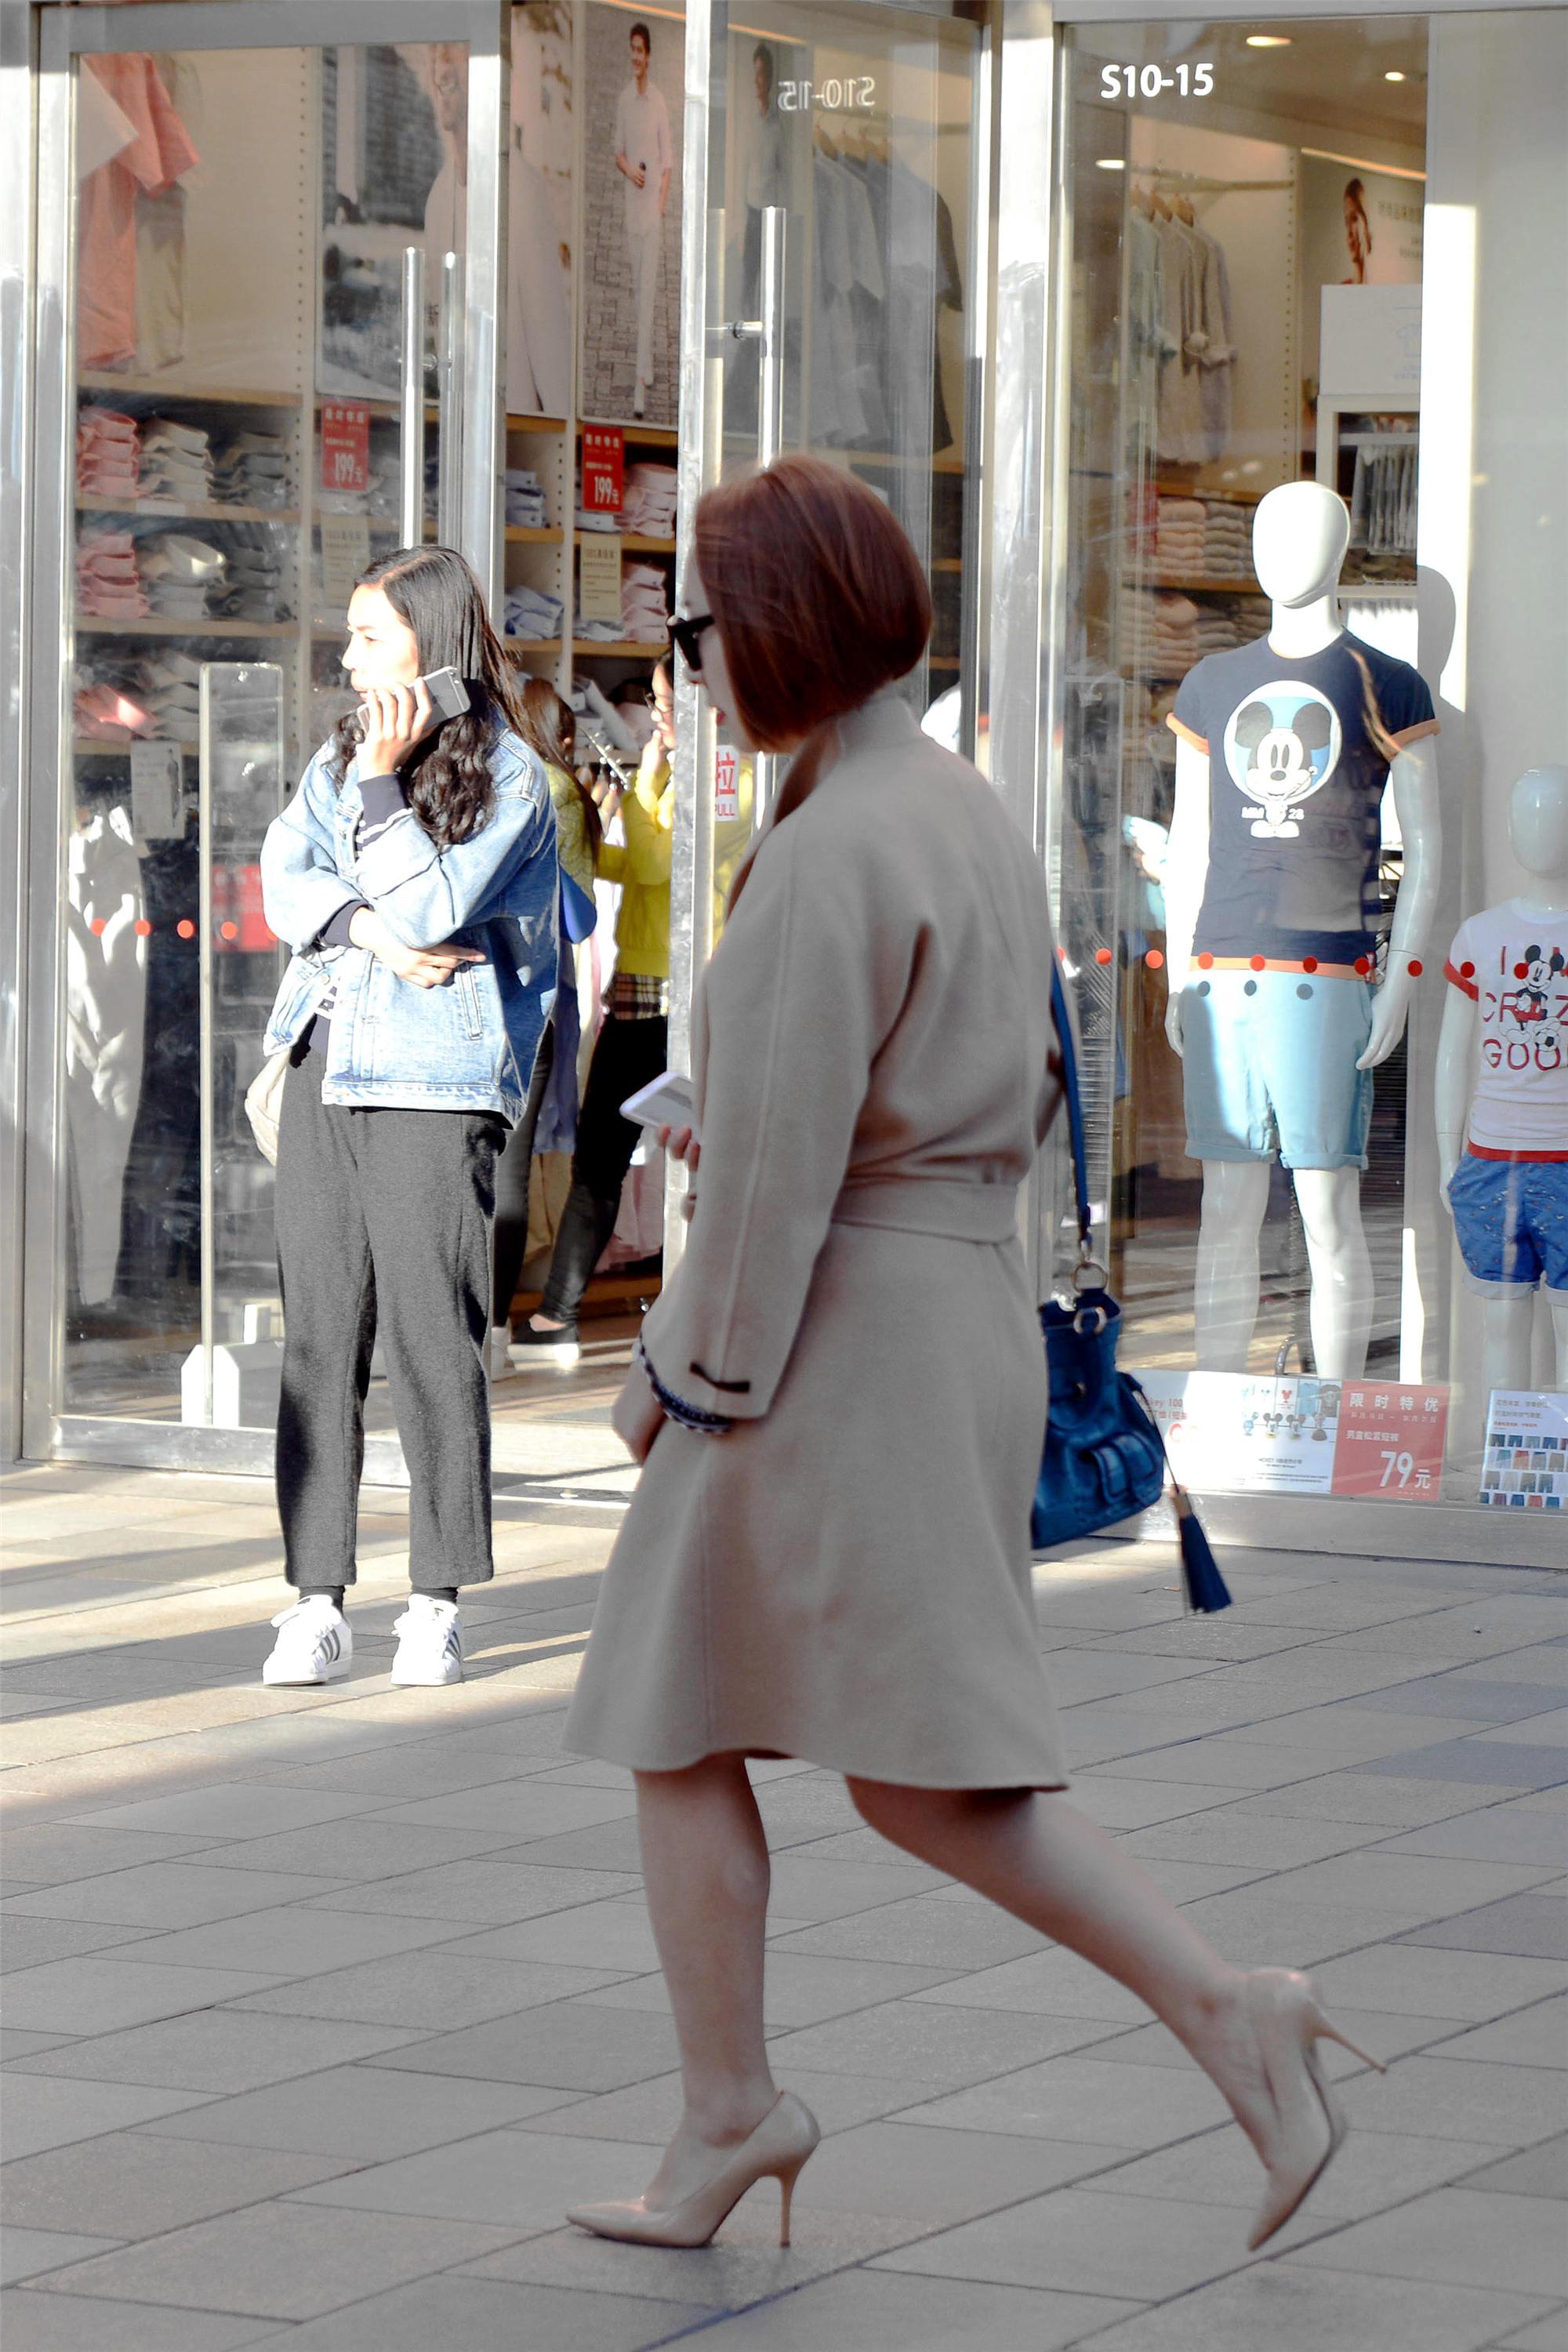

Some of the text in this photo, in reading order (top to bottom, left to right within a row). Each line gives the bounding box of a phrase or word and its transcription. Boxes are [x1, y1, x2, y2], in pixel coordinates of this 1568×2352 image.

[1100, 63, 1214, 99] S10-15
[715, 804, 735, 816] ULL
[1288, 808, 1305, 820] 28
[1483, 1038, 1568, 1072] GOO
[1349, 1392, 1439, 1413] 限时特优
[1380, 1451, 1431, 1489] 79元
